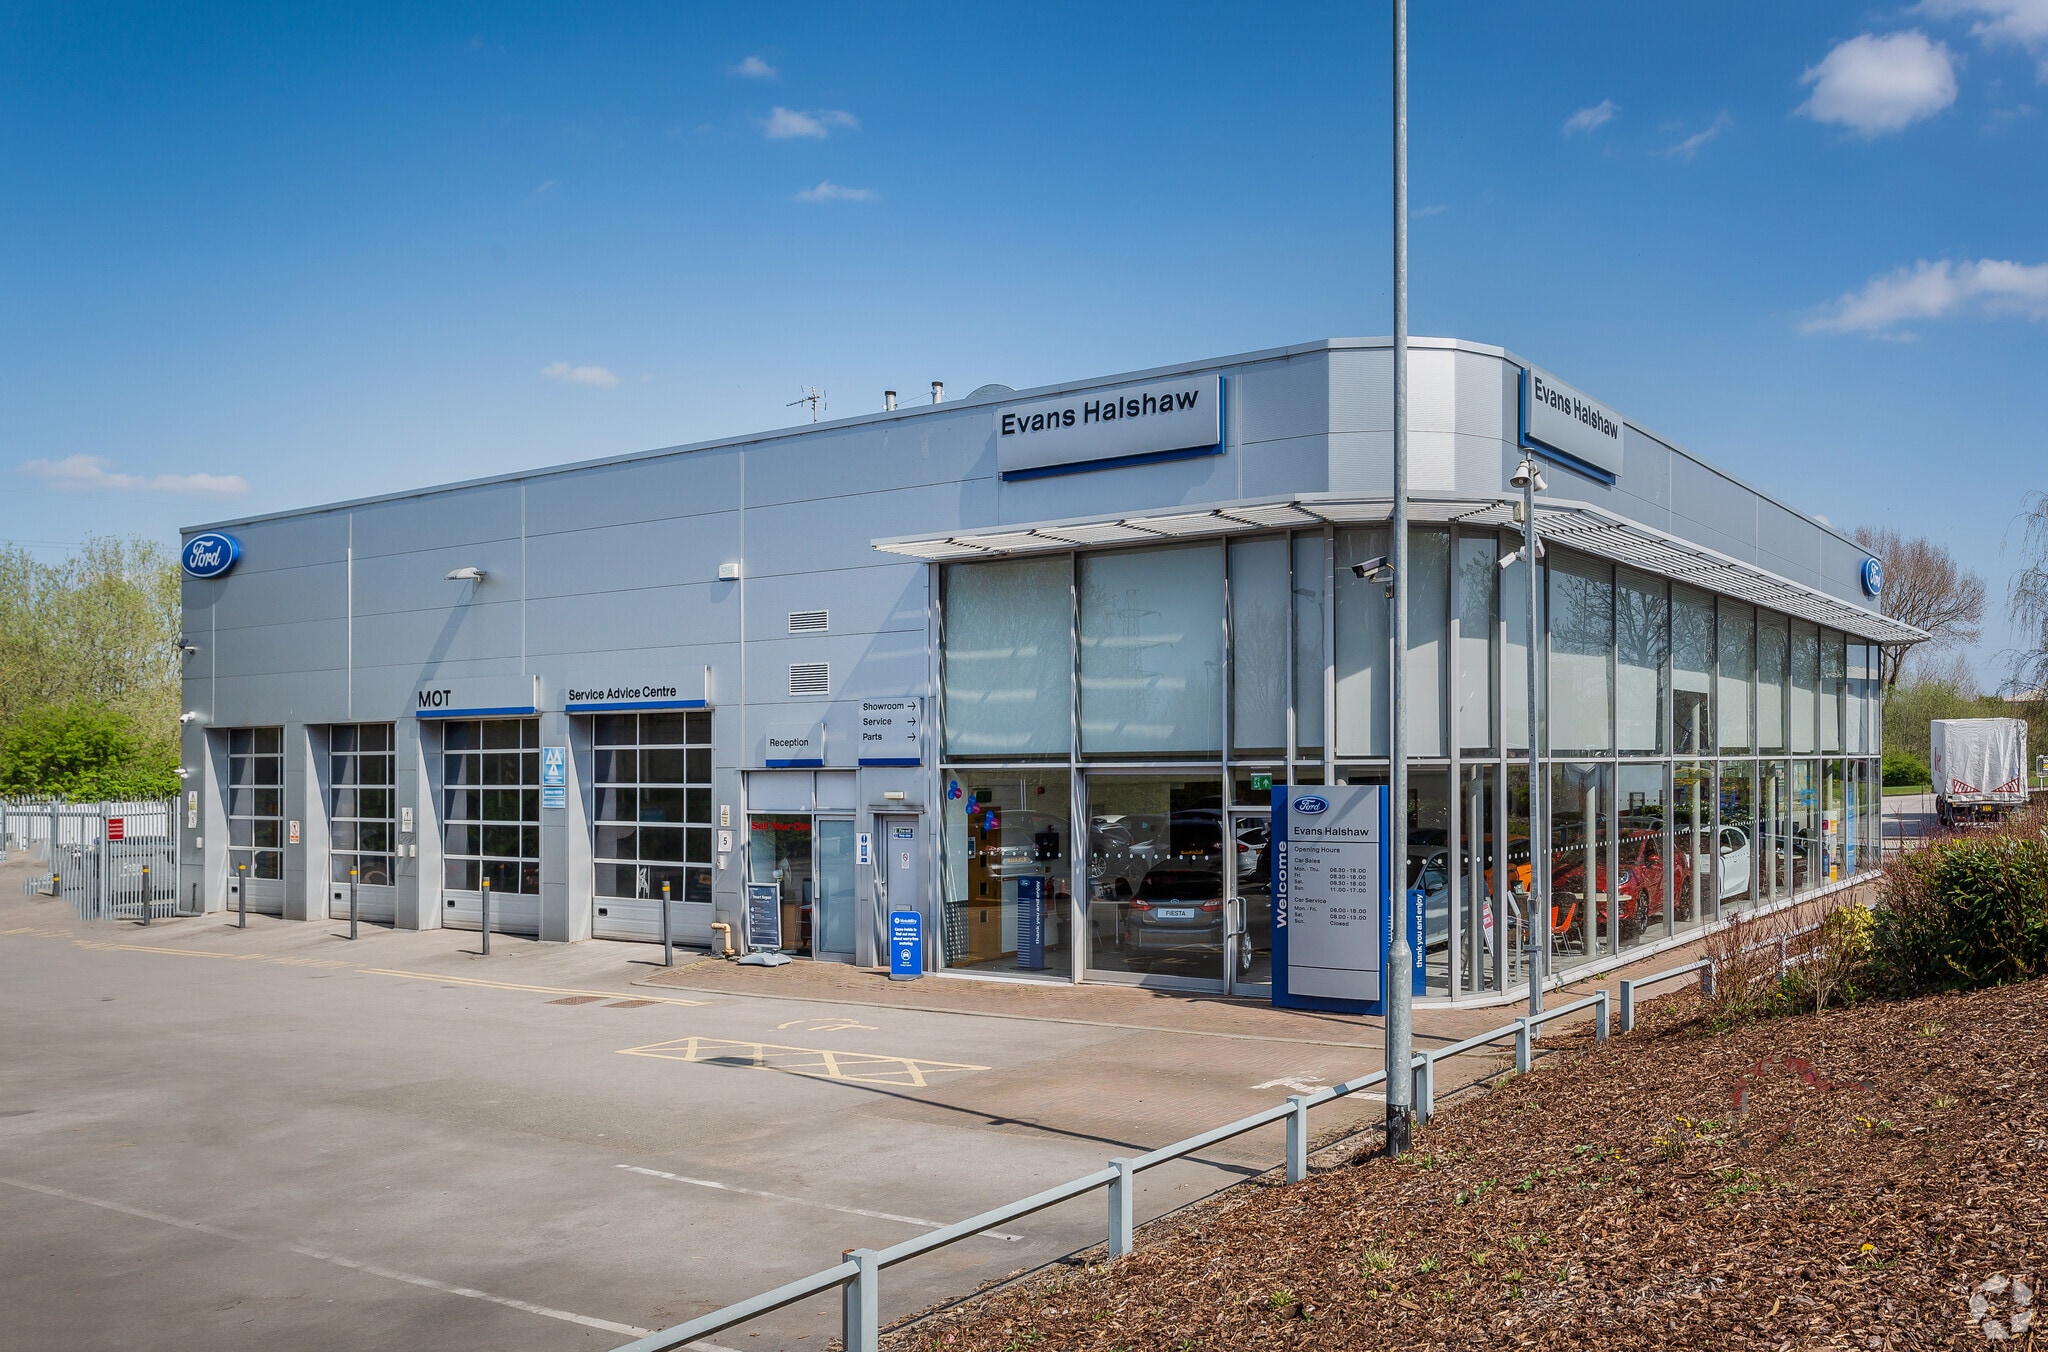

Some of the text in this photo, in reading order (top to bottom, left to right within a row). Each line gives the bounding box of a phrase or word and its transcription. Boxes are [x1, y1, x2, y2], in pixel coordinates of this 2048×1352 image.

[1001, 390, 1199, 435] Evans Halshaw
[1535, 377, 1618, 439] Evans Halshaw
[189, 540, 221, 568] Ford
[1870, 562, 1880, 588] Ford
[418, 690, 451, 707] MOT
[568, 686, 677, 701] Service Advice Centre
[862, 702, 904, 711] Showroom
[862, 717, 892, 726] Service
[769, 737, 809, 748] Reception
[862, 733, 883, 741] Parts
[1300, 799, 1321, 811] Ford
[751, 821, 811, 831] Sell Your Car
[1294, 826, 1369, 836] Evans Halshaw
[723, 836, 728, 846] 5
[1294, 846, 1320, 854] Opening
[1276, 841, 1287, 928] Welcome
[1415, 893, 1424, 915] enjoy
[1415, 915, 1423, 930] and
[1415, 945, 1423, 968] thank
